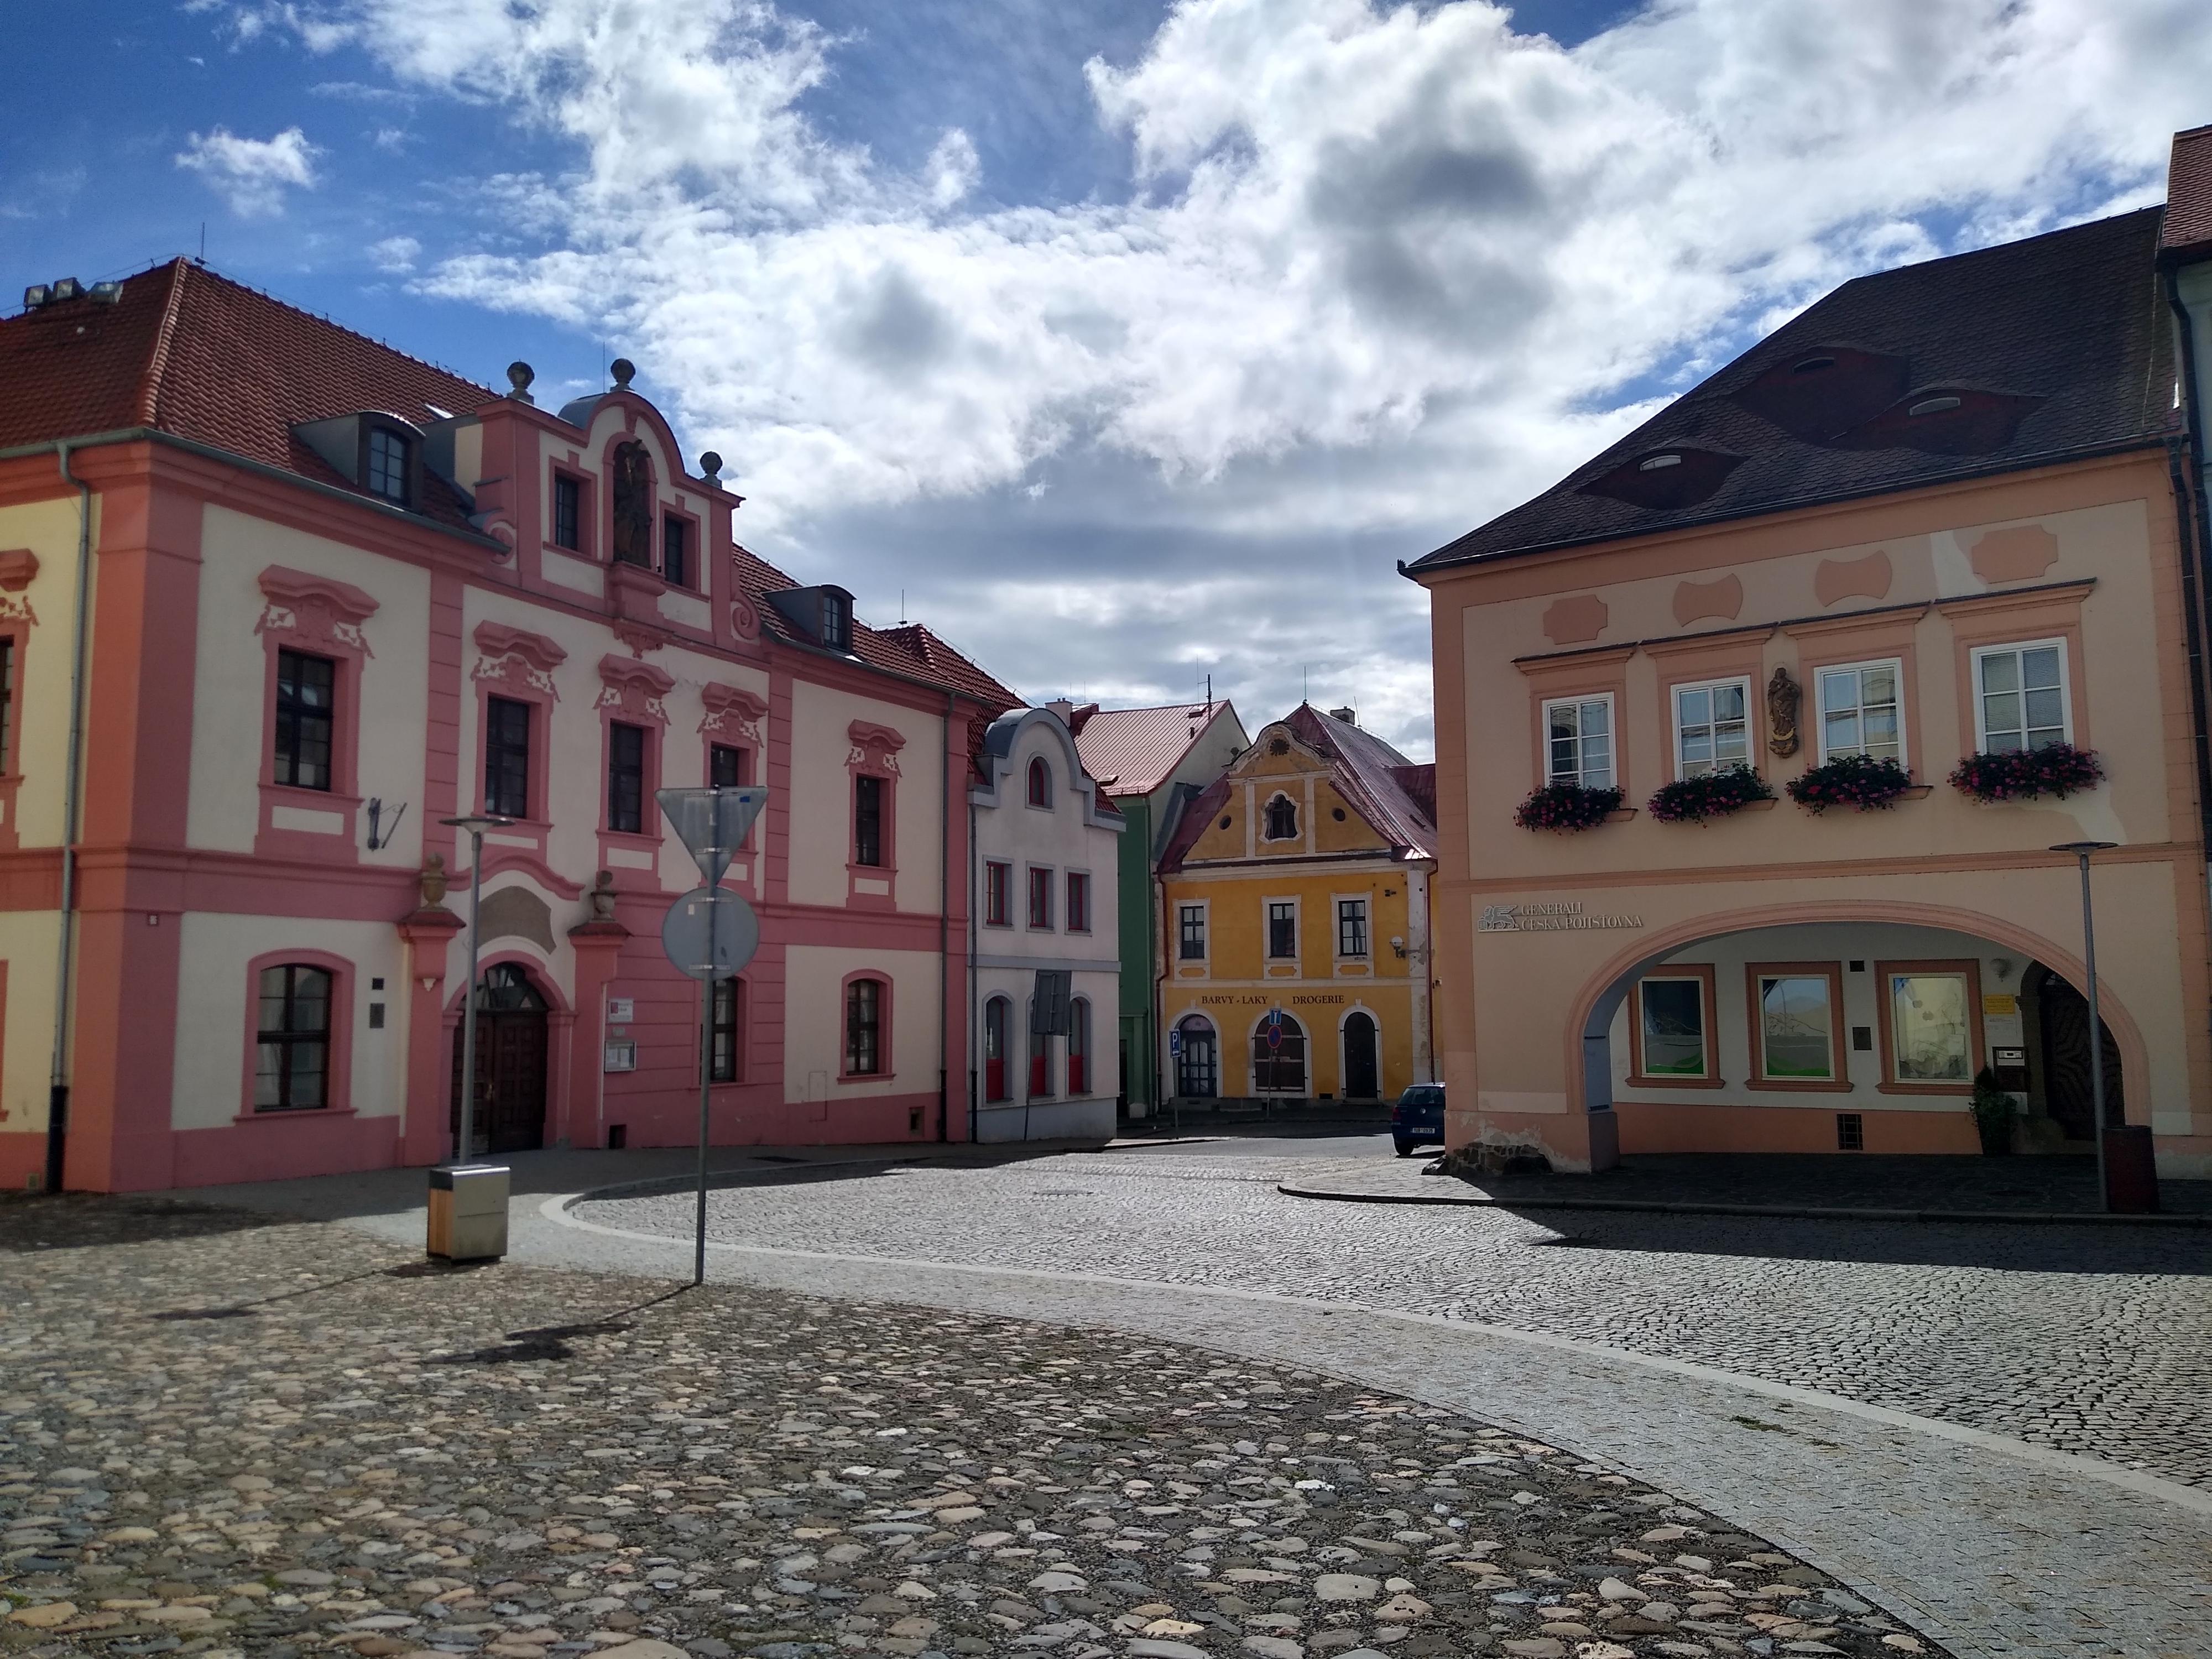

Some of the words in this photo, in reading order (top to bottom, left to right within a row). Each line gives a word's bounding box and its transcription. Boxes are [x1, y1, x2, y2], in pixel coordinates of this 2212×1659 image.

[1521, 902, 1582, 916] GENERALI
[1201, 995, 1234, 1004] BARVY
[1242, 995, 1268, 1004] LAKY
[1292, 995, 1345, 1005] DROGERIE
[1172, 1032, 1178, 1048] P
